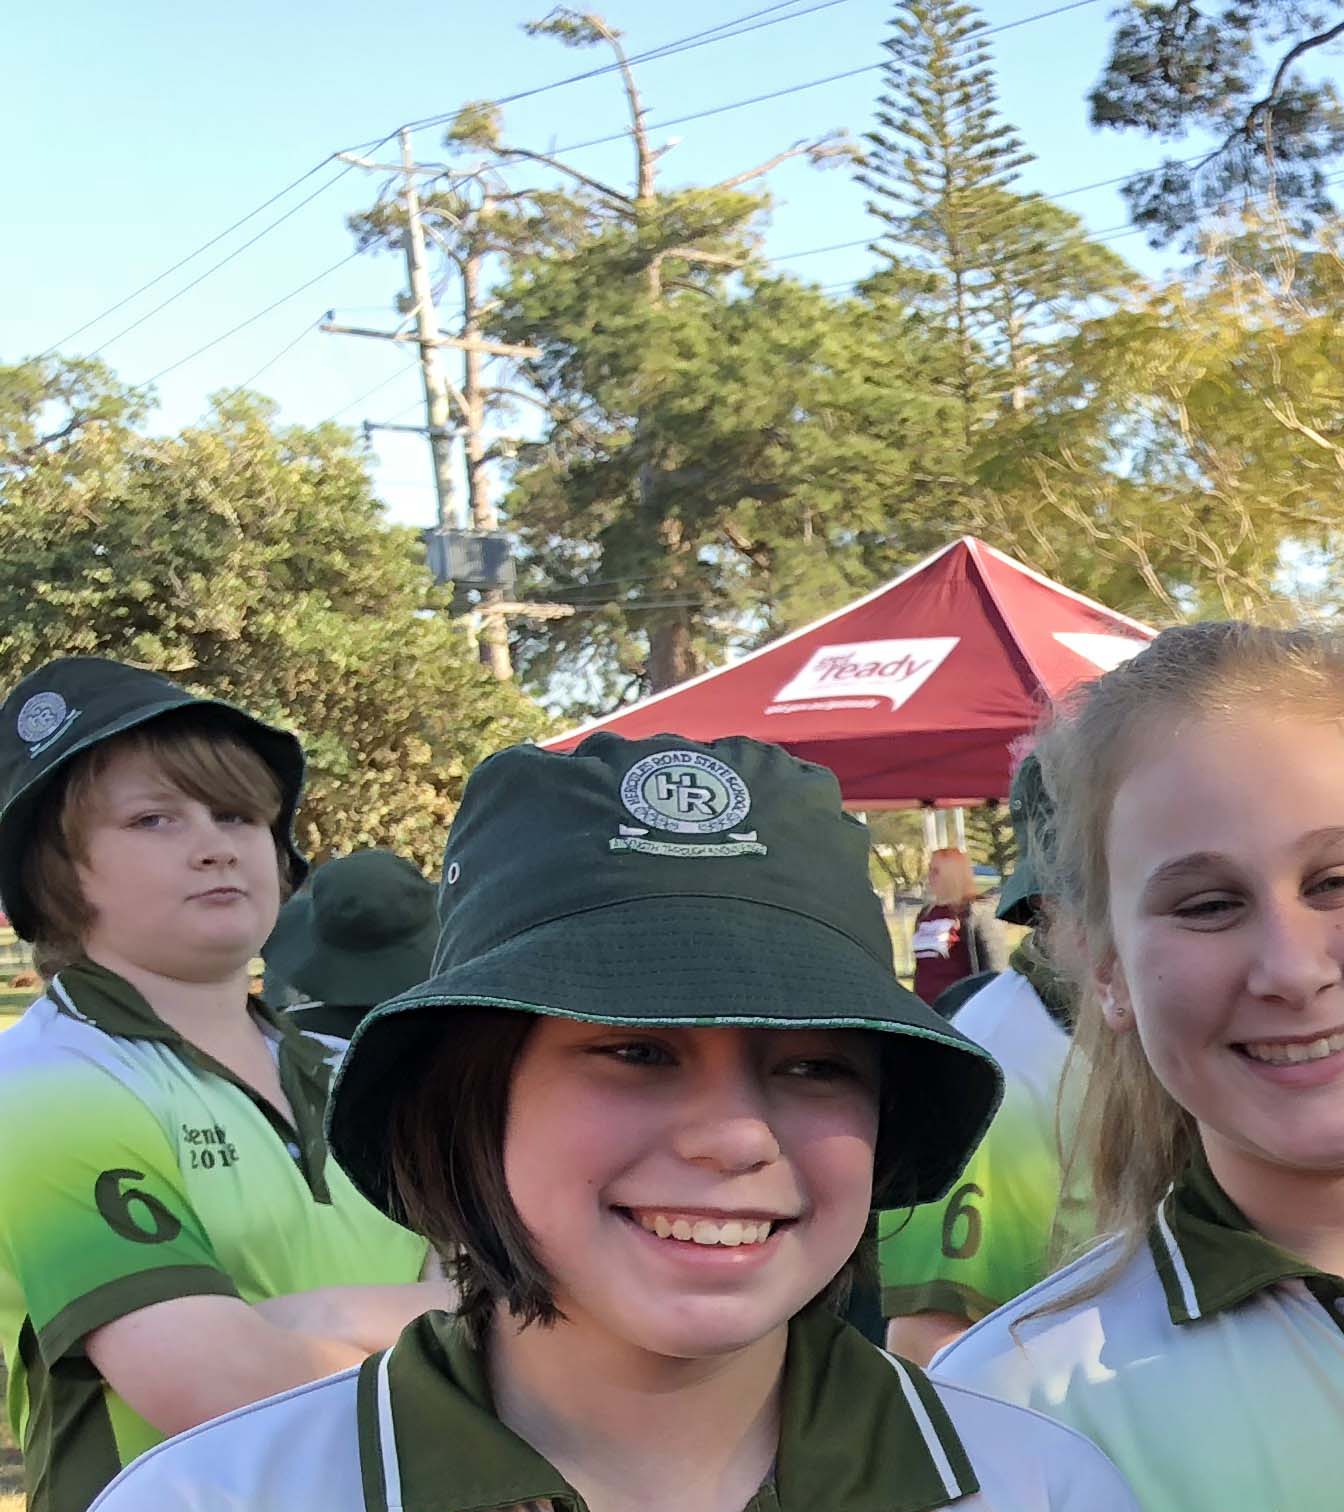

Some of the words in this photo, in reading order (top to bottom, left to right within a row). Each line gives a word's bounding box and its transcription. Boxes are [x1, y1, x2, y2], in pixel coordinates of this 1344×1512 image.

[819, 654, 933, 683] ready
[651, 753, 693, 766] ROAD
[655, 771, 719, 815] HR
[95, 1168, 182, 1244] 6
[941, 1183, 984, 1259] 6
